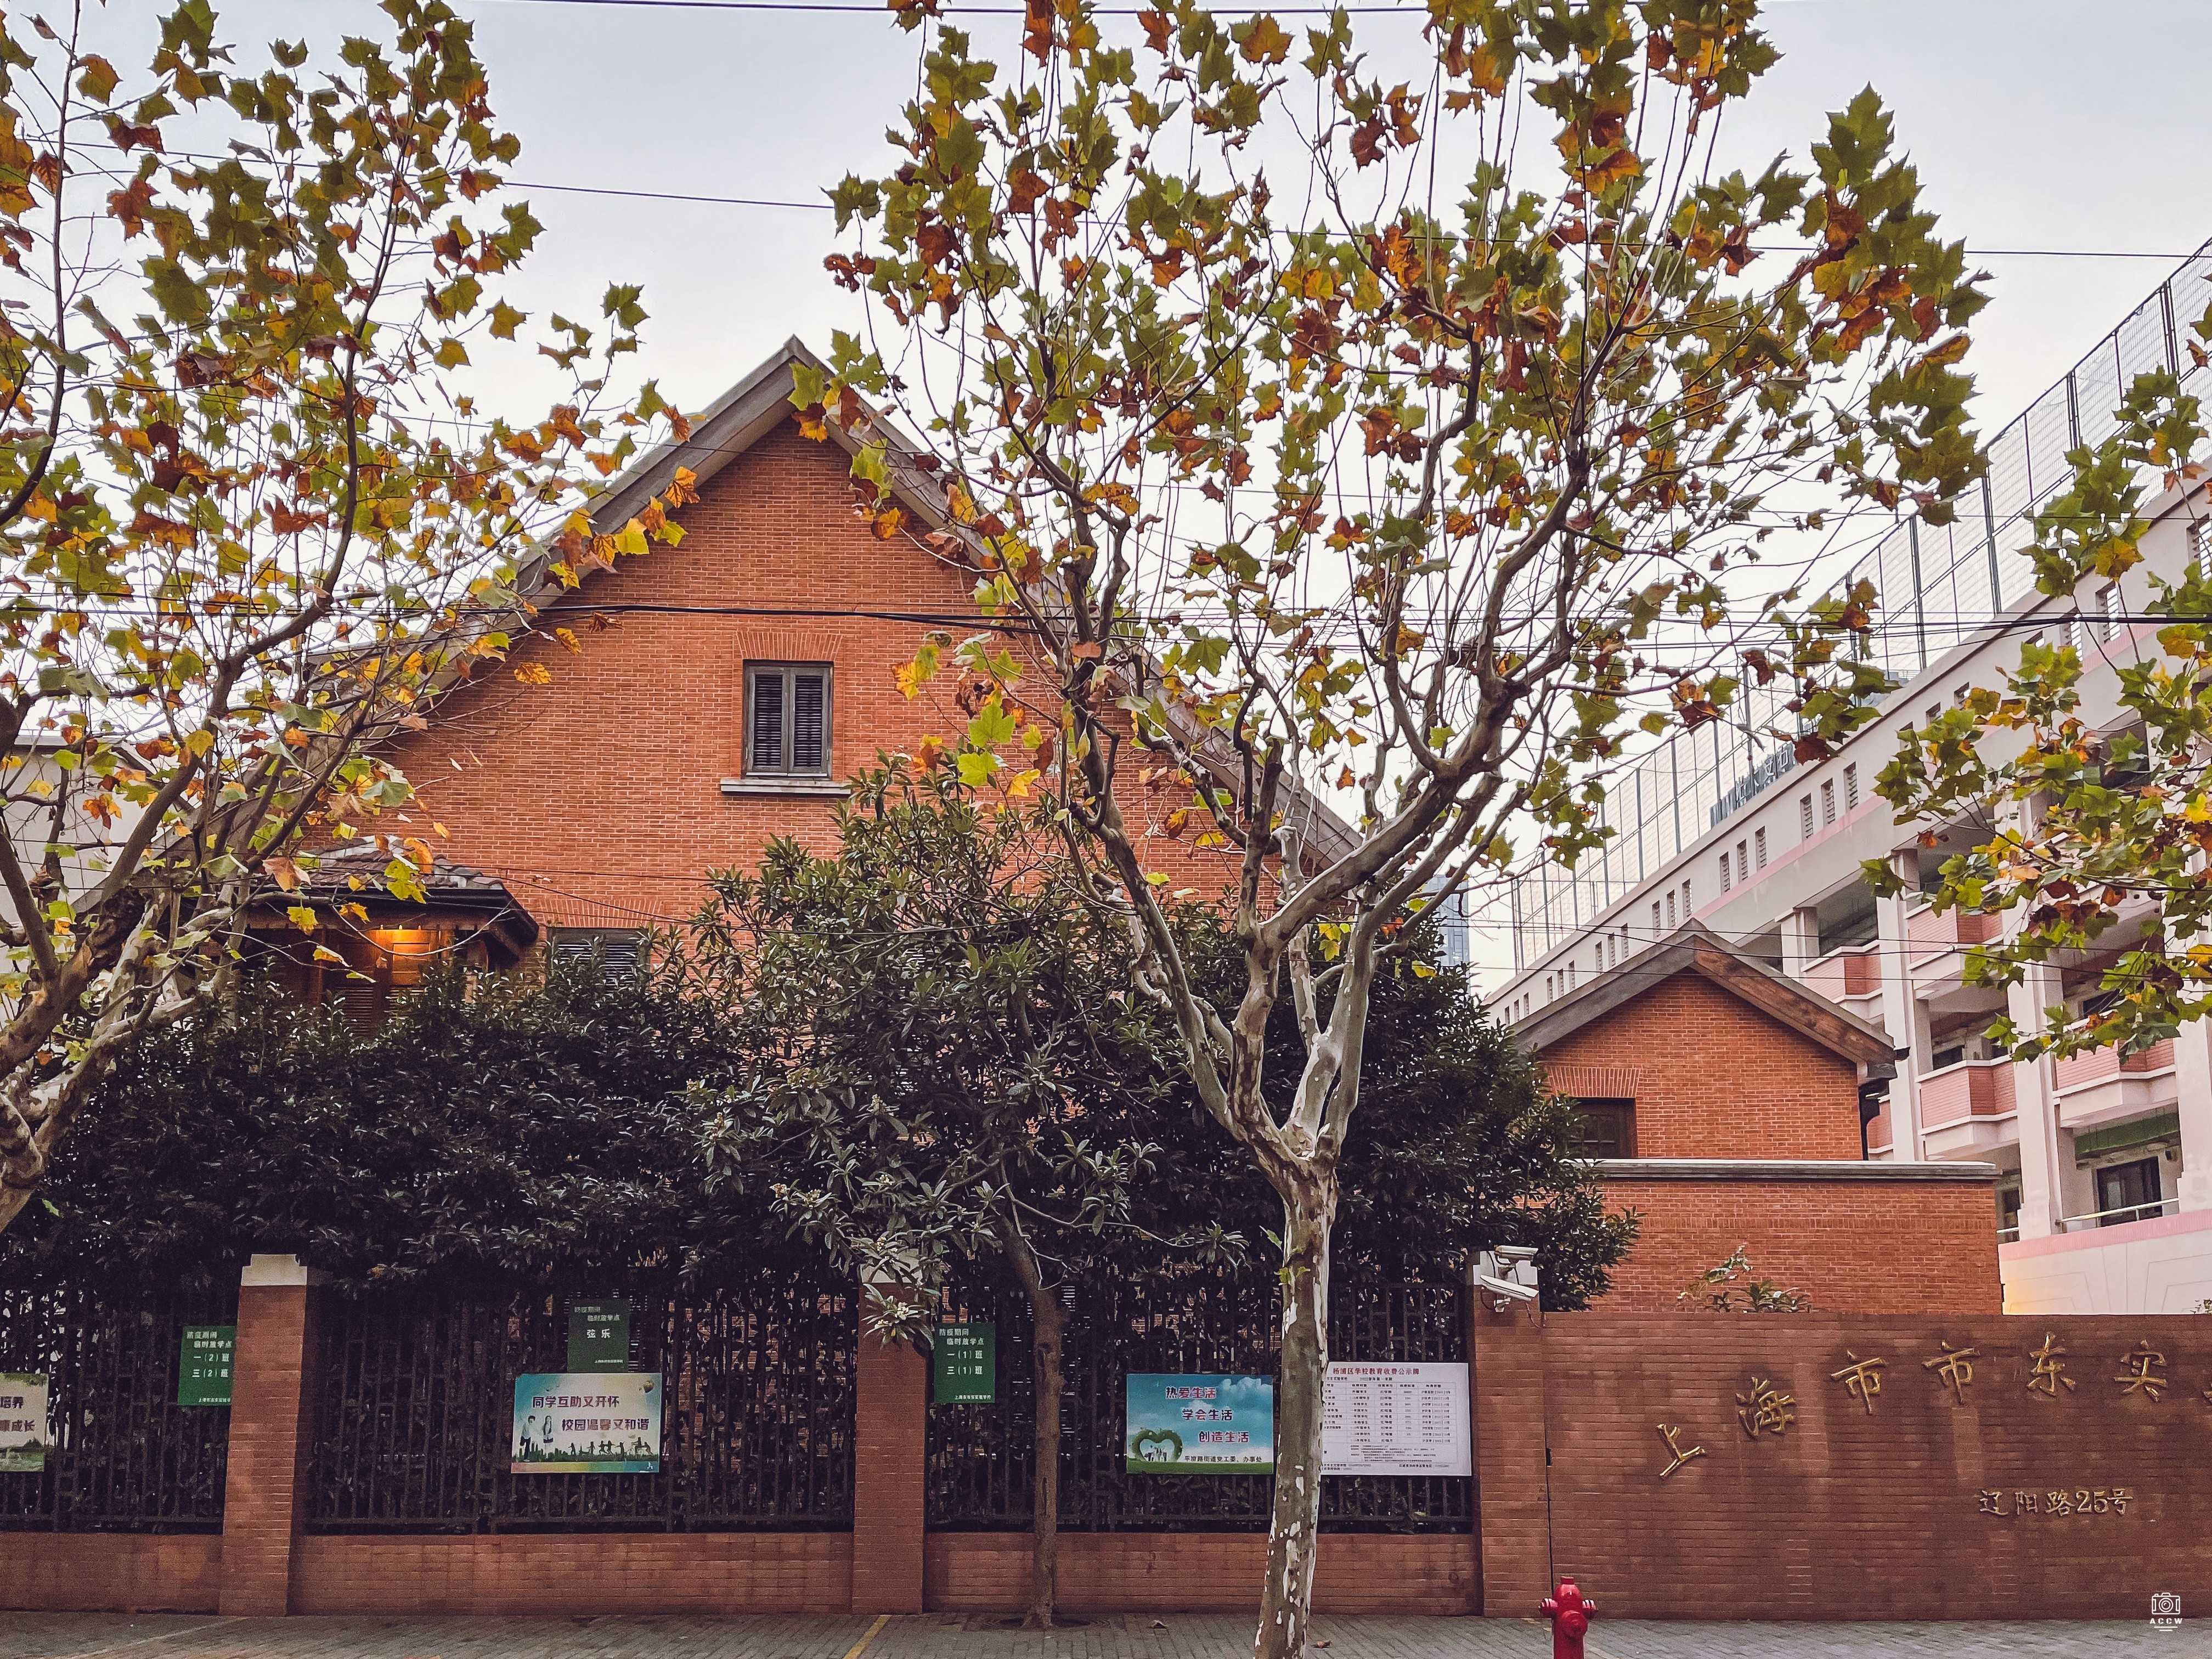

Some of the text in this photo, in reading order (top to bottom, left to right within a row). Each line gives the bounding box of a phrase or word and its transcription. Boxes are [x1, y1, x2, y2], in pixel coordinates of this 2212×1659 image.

[1165, 1386, 1216, 1399] 热爱生活
[532, 1396, 619, 1408] 同学互助又开怀
[1656, 1332, 2212, 1479] 上海市市东实
[1182, 1408, 1232, 1421] 学会生活
[561, 1418, 650, 1431] 校园温馨又和谐
[1198, 1431, 1250, 1443] 创造生活
[1979, 1488, 2134, 1516] 辽阳路25号
